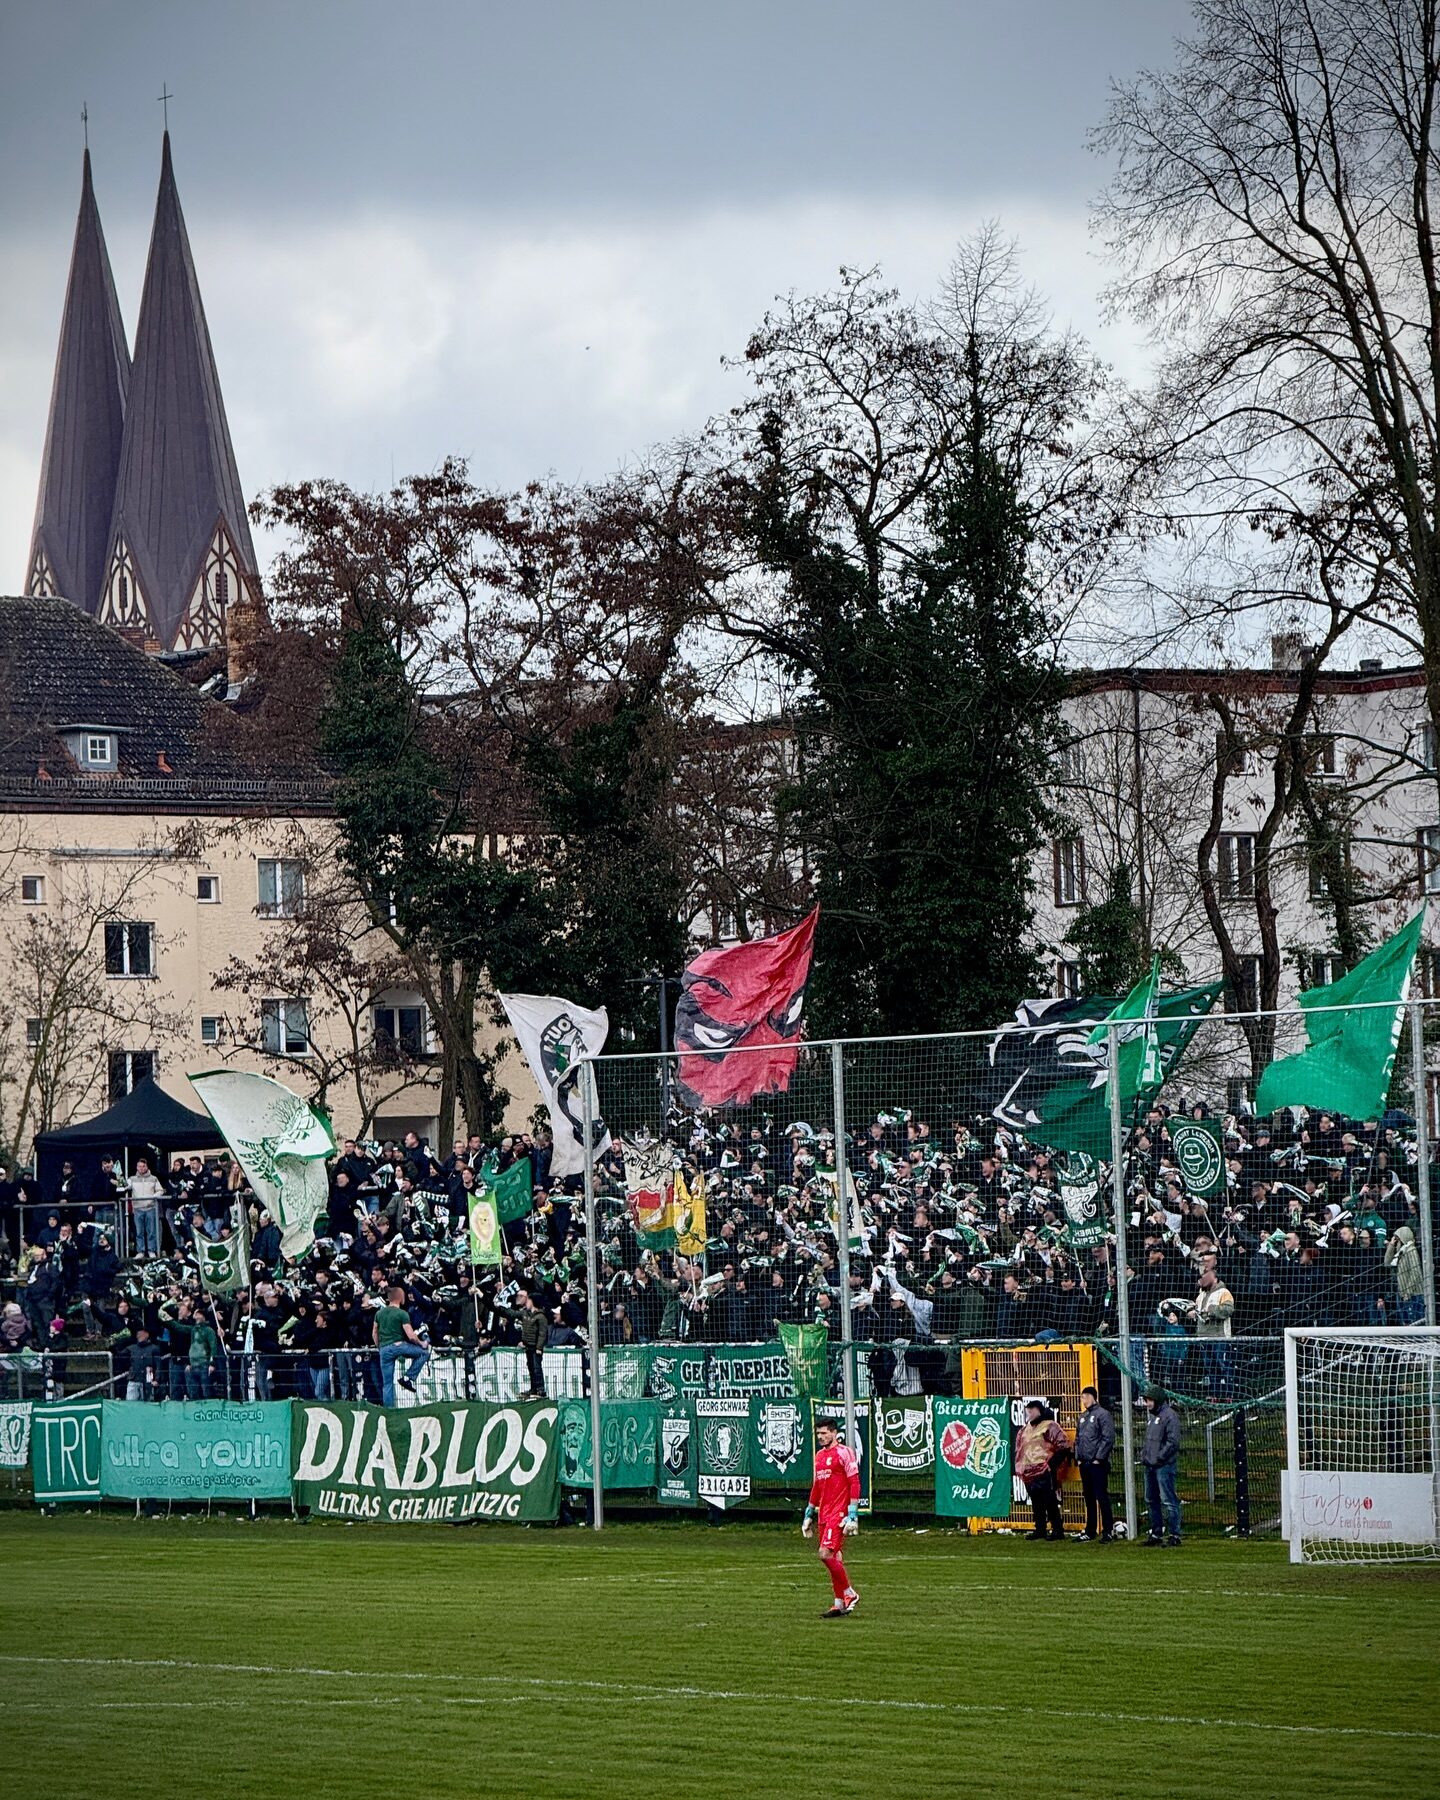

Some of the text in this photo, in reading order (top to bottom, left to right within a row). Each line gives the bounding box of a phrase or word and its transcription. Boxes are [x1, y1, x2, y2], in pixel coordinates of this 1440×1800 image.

[698, 1401, 718, 1412] GEORG
[935, 1395, 1008, 1415] Bierstand
[195, 1432, 283, 1469] youth
[293, 1407, 559, 1490] DIABLOS
[887, 1455, 925, 1467] KOMBINAT
[700, 1479, 749, 1492] BRIGADE
[952, 1482, 994, 1499] Pöbel
[318, 1490, 381, 1518] ULTRAS
[388, 1496, 458, 1520] CHEMIE
